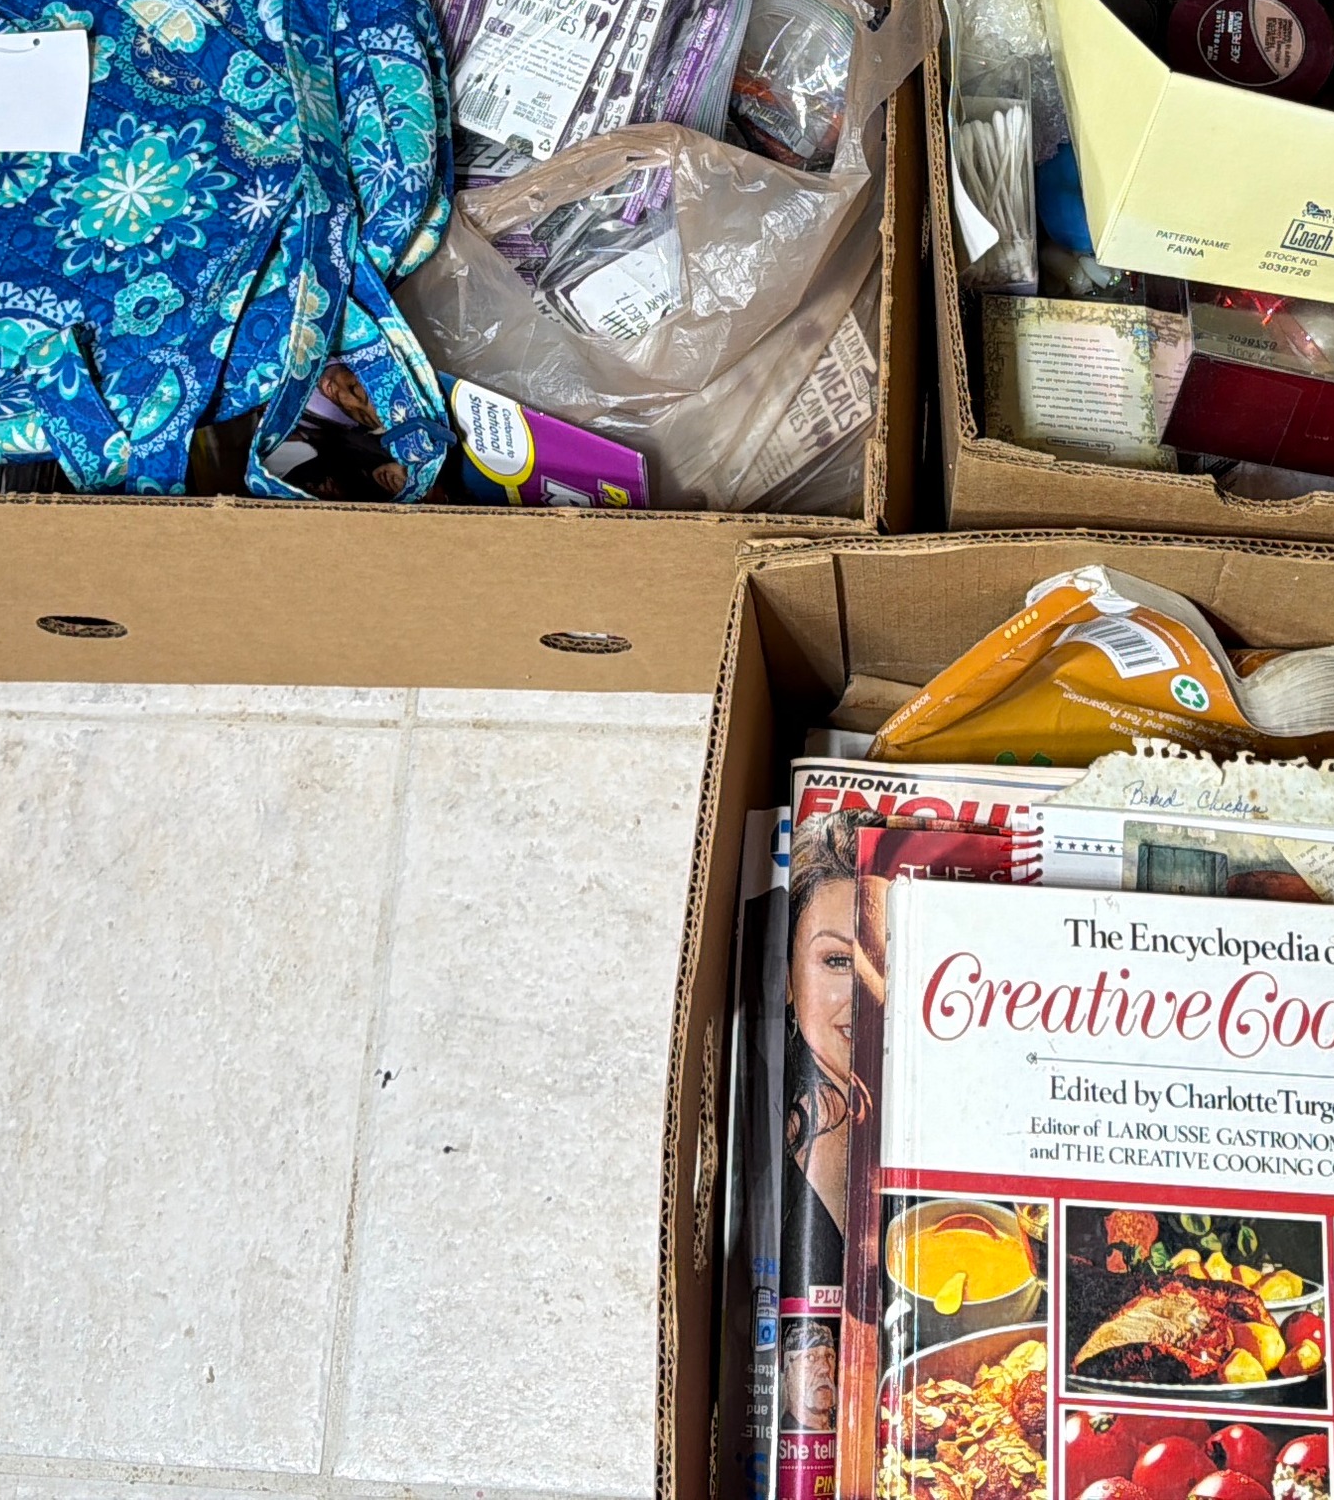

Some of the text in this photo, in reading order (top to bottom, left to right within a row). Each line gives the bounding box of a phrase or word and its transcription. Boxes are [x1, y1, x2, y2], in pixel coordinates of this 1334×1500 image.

[1155, 230, 1231, 251] PATTERN NAME
[1167, 243, 1206, 259] FAINA
[1288, 222, 1332, 252] Coach
[468, 393, 486, 454] Standards
[485, 400, 505, 456] National
[909, 691, 933, 716] BOOK
[804, 773, 920, 796] NATIONAL
[1064, 918, 1124, 951] The
[1129, 922, 1323, 965] Encyclopedia
[921, 952, 1212, 1042] Creative
[1048, 1075, 1131, 1104] Edited
[1133, 1080, 1162, 1109] by
[1165, 1082, 1278, 1113] Charlotte
[1029, 1116, 1079, 1138] Editor
[1081, 1118, 1101, 1138] of
[1105, 1119, 1212, 1146] LAROUSSE
[1029, 1143, 1061, 1164] and
[1061, 1144, 1106, 1165] THE
[1107, 1146, 1210, 1171] CREATIVE
[1211, 1152, 1315, 1177] COOKING
[779, 1440, 809, 1461] She
